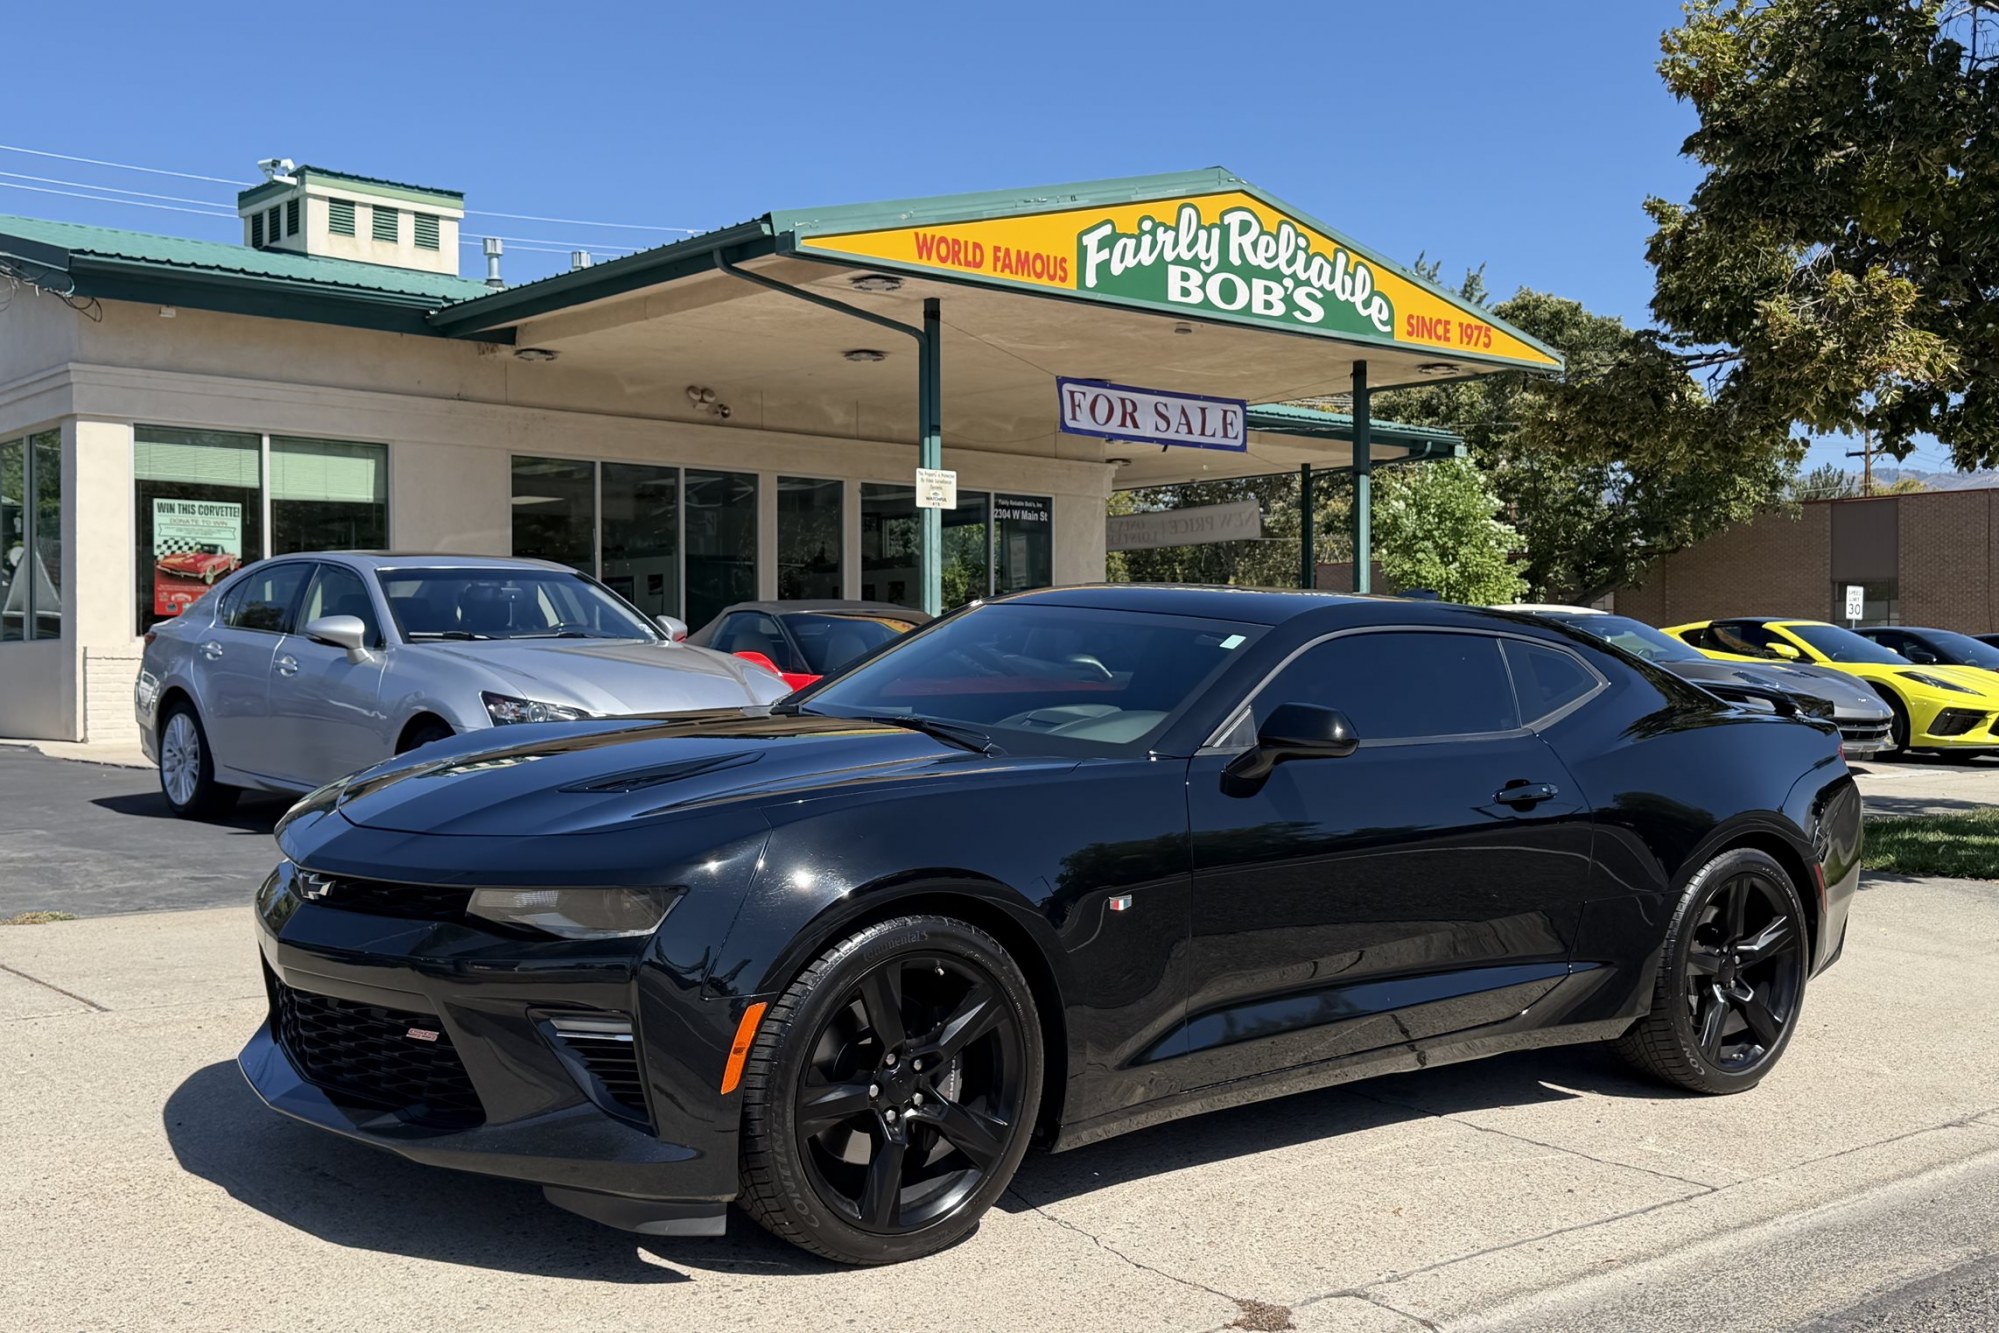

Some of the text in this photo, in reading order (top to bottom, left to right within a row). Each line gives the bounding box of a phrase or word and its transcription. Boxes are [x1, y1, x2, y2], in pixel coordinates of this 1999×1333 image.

[914, 231, 1068, 283] WORLD FAMOUS
[1082, 206, 1392, 332] Fairly Reliable
[1167, 264, 1325, 323] BOB'S
[1406, 313, 1492, 349] SINCE 1975
[1067, 389, 1239, 440] FOR SALE
[157, 502, 241, 518] WIN THIS CORVETTE!
[169, 517, 199, 525] DONATE
[994, 508, 1048, 521] 2304 W Main St
[1848, 603, 1861, 615] 30
